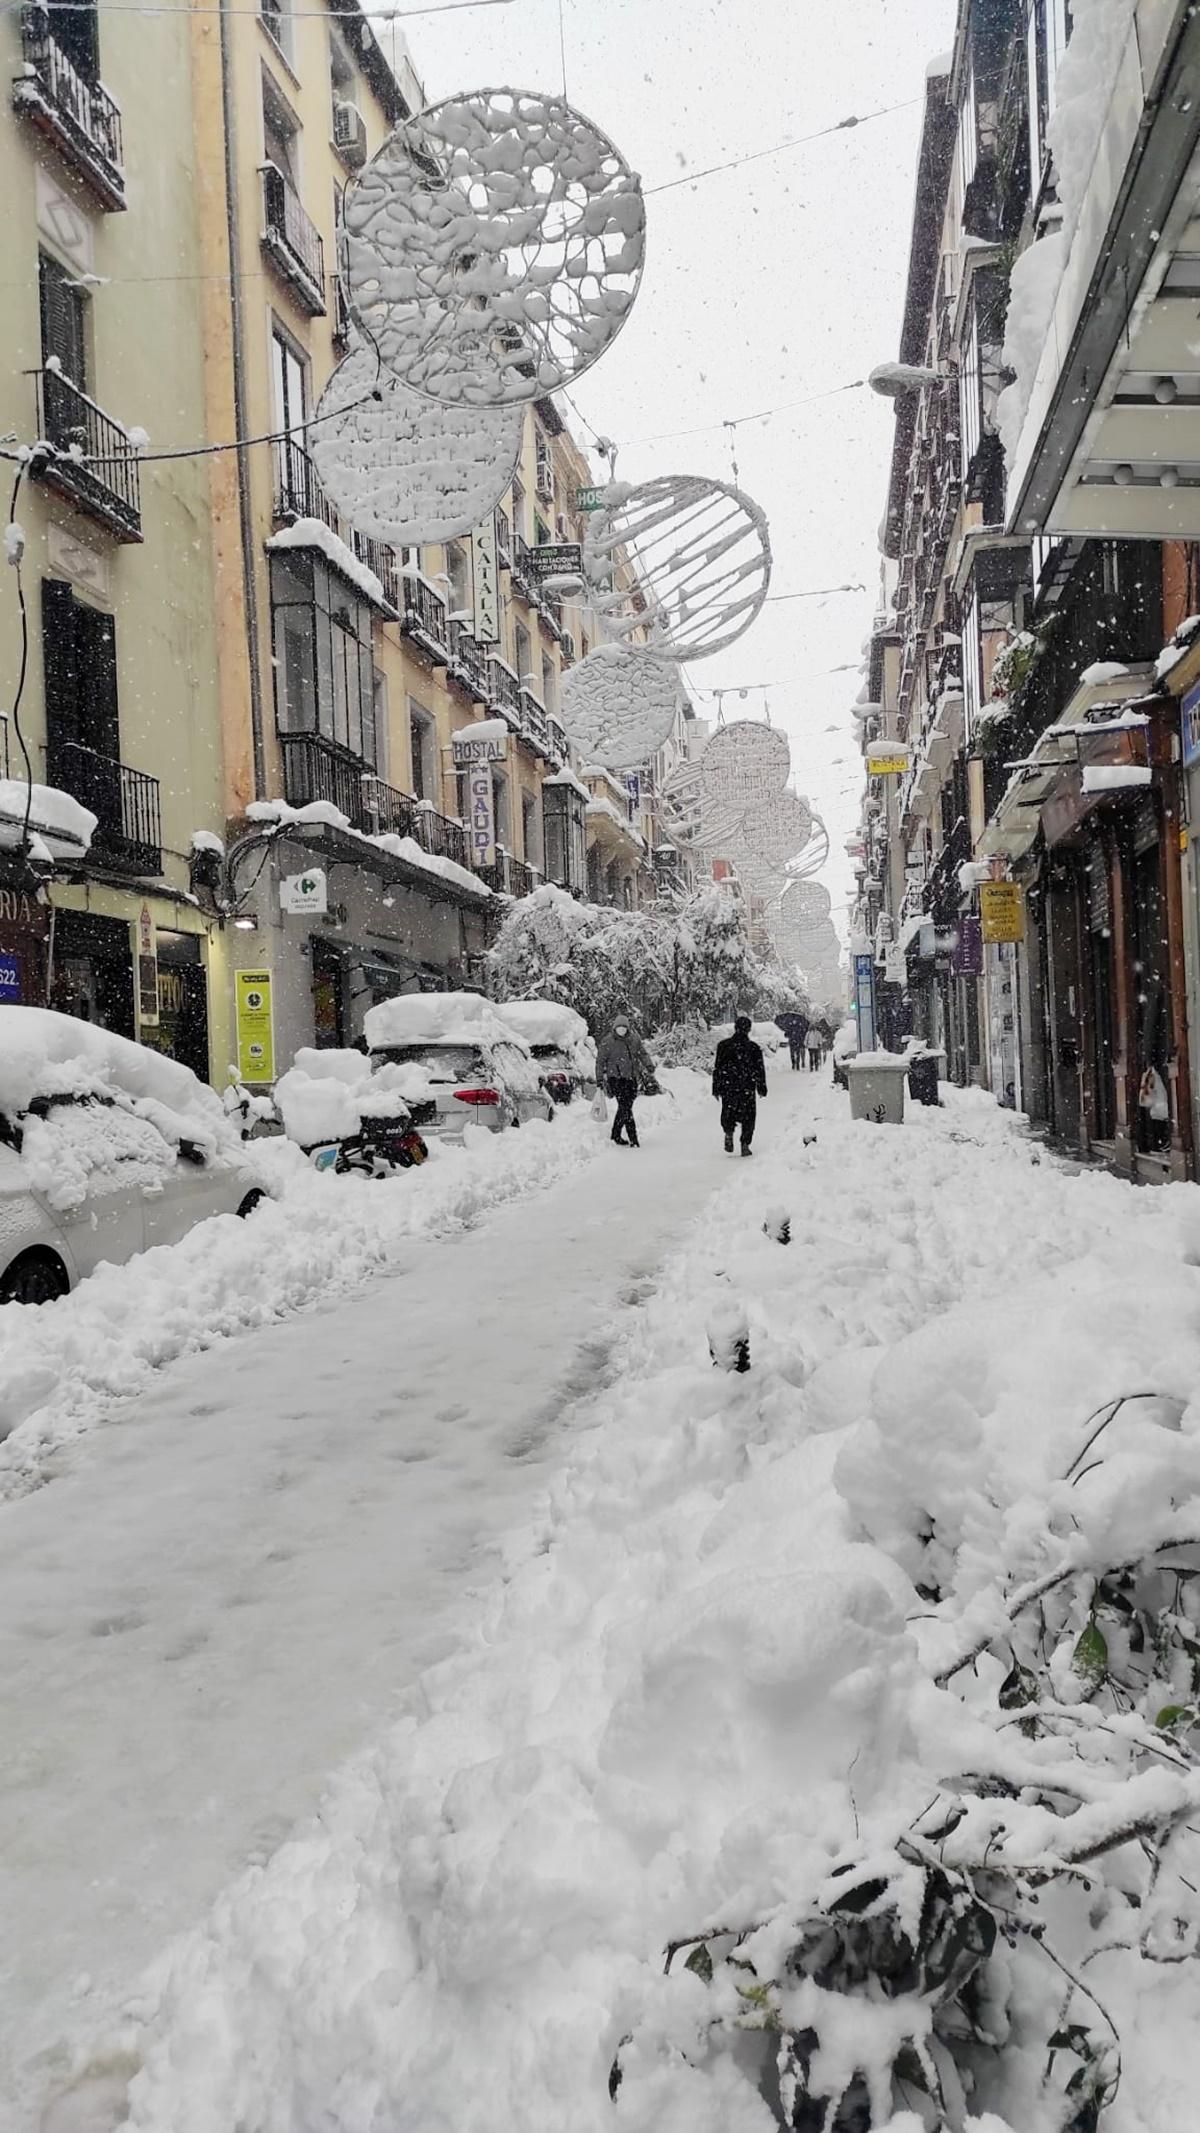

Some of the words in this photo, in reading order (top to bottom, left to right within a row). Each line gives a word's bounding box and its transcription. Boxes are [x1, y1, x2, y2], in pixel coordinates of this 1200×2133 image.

[578, 491, 602, 505] HOS
[477, 536, 496, 639] CATALAN
[454, 741, 504, 760] HOSTAL
[472, 780, 490, 865] GAUDI
[0, 889, 31, 922] RIA
